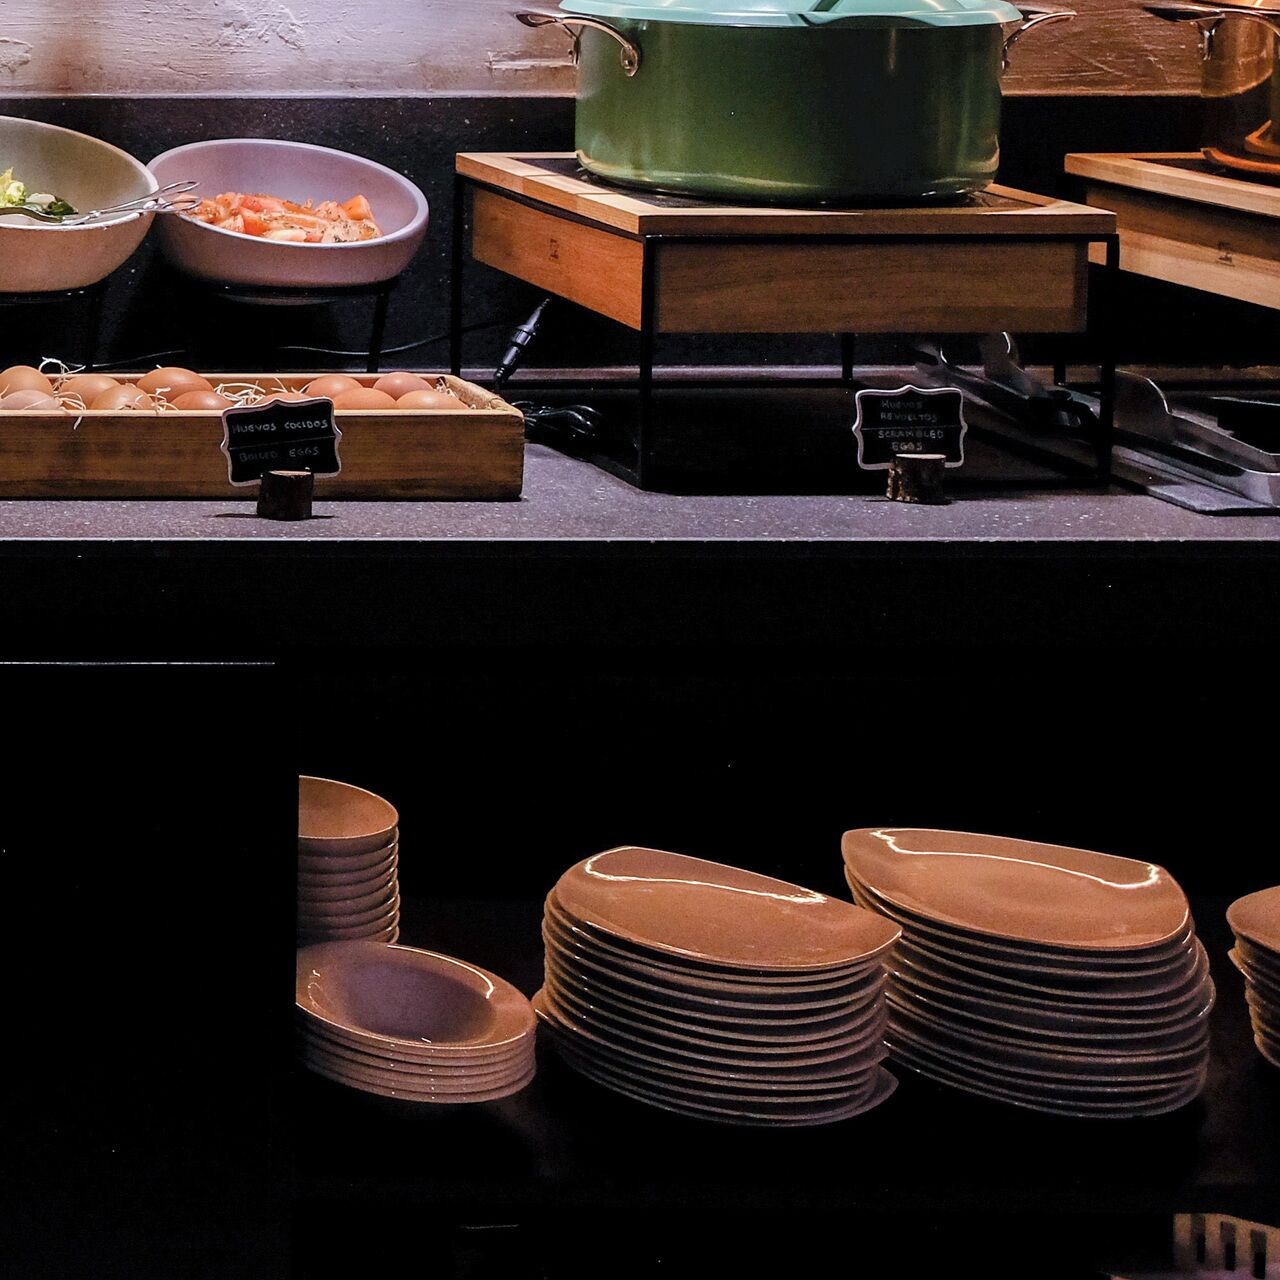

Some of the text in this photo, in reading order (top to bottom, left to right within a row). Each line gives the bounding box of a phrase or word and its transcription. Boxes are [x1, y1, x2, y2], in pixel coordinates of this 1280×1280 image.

[232, 419, 328, 433] HUEVOS COCIDOS
[878, 430, 944, 439] SCRAMBLED
[891, 441, 923, 451] EGGS
[289, 447, 320, 458] EGGS
